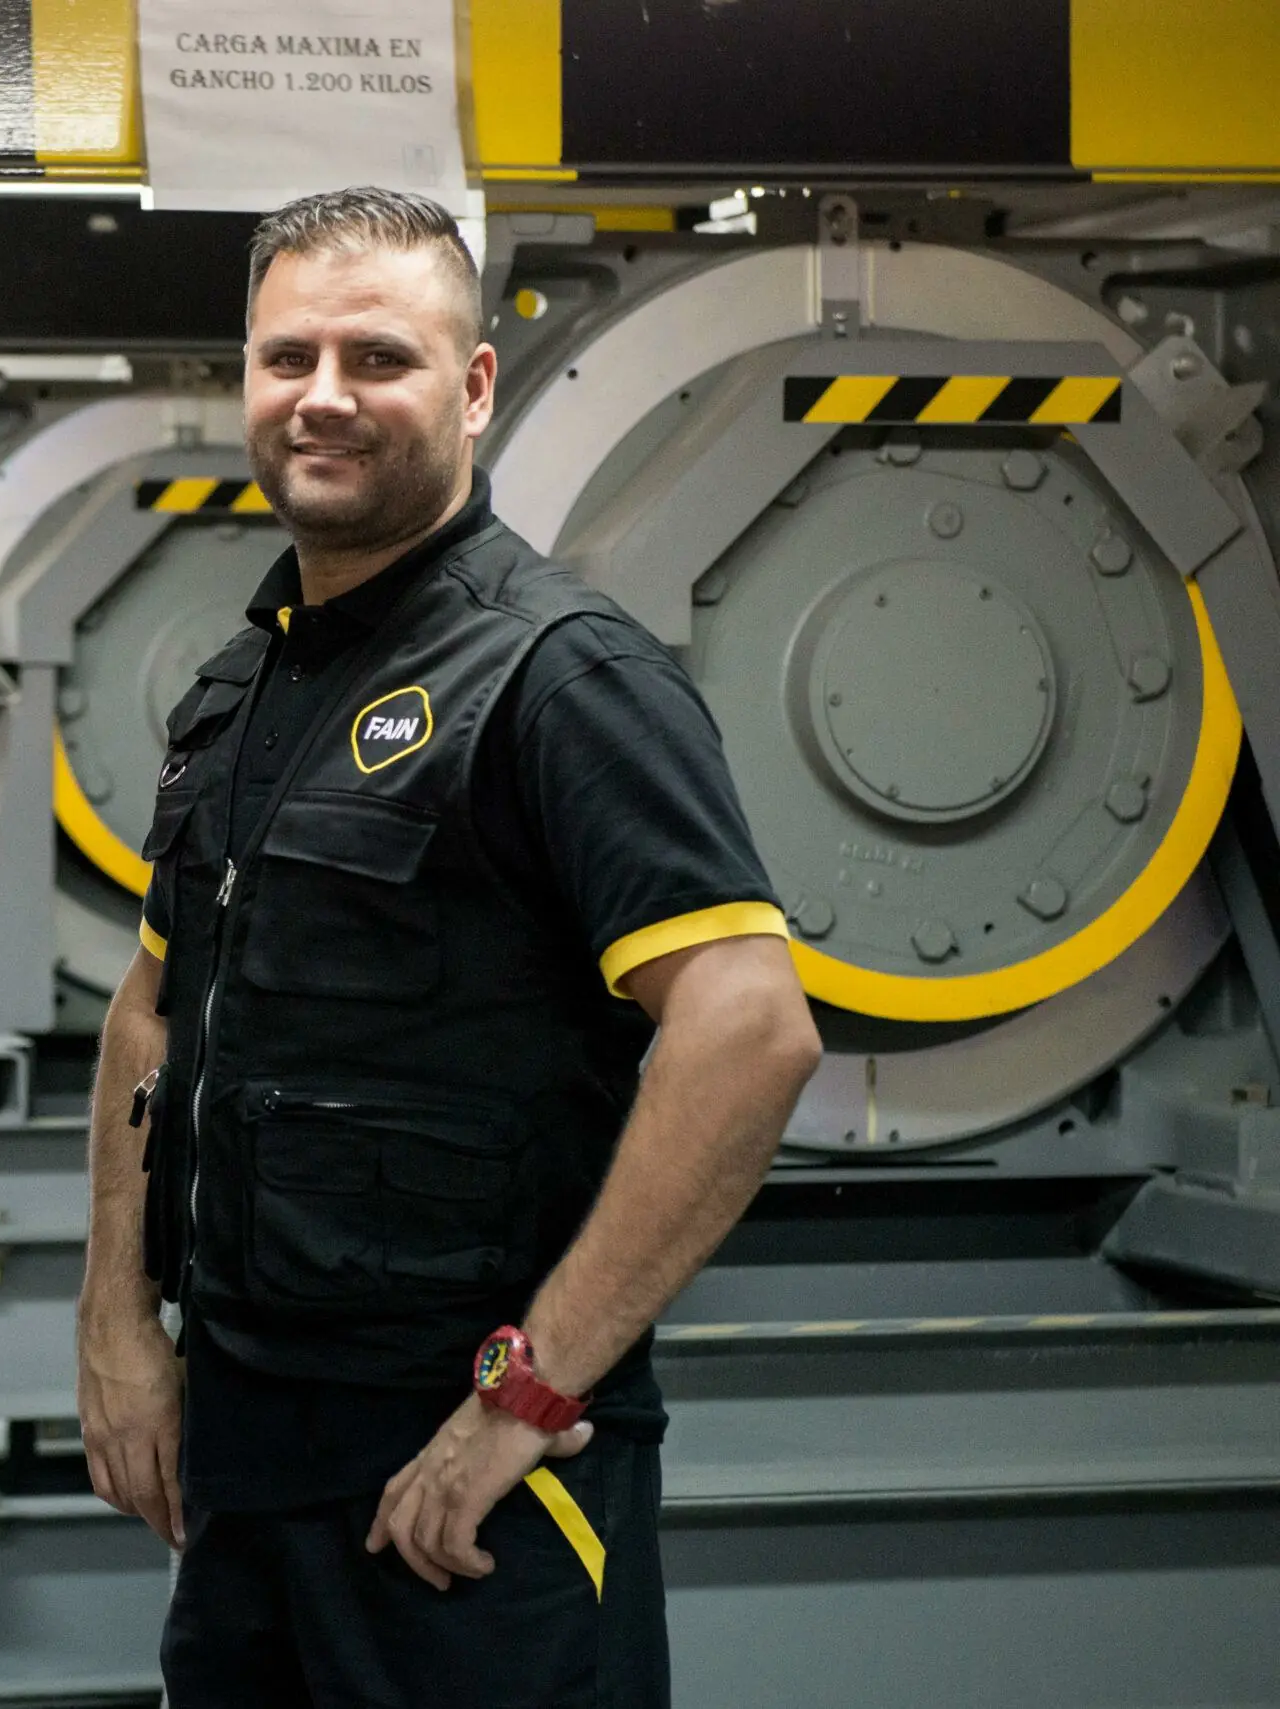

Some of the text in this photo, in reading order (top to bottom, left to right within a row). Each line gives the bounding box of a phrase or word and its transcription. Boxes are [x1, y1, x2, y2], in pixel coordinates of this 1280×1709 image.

[177, 33, 421, 58] CARGA MAXIMA EN
[170, 69, 432, 94] GANCHO 1.200 KILOS
[364, 716, 419, 741] FAIN
